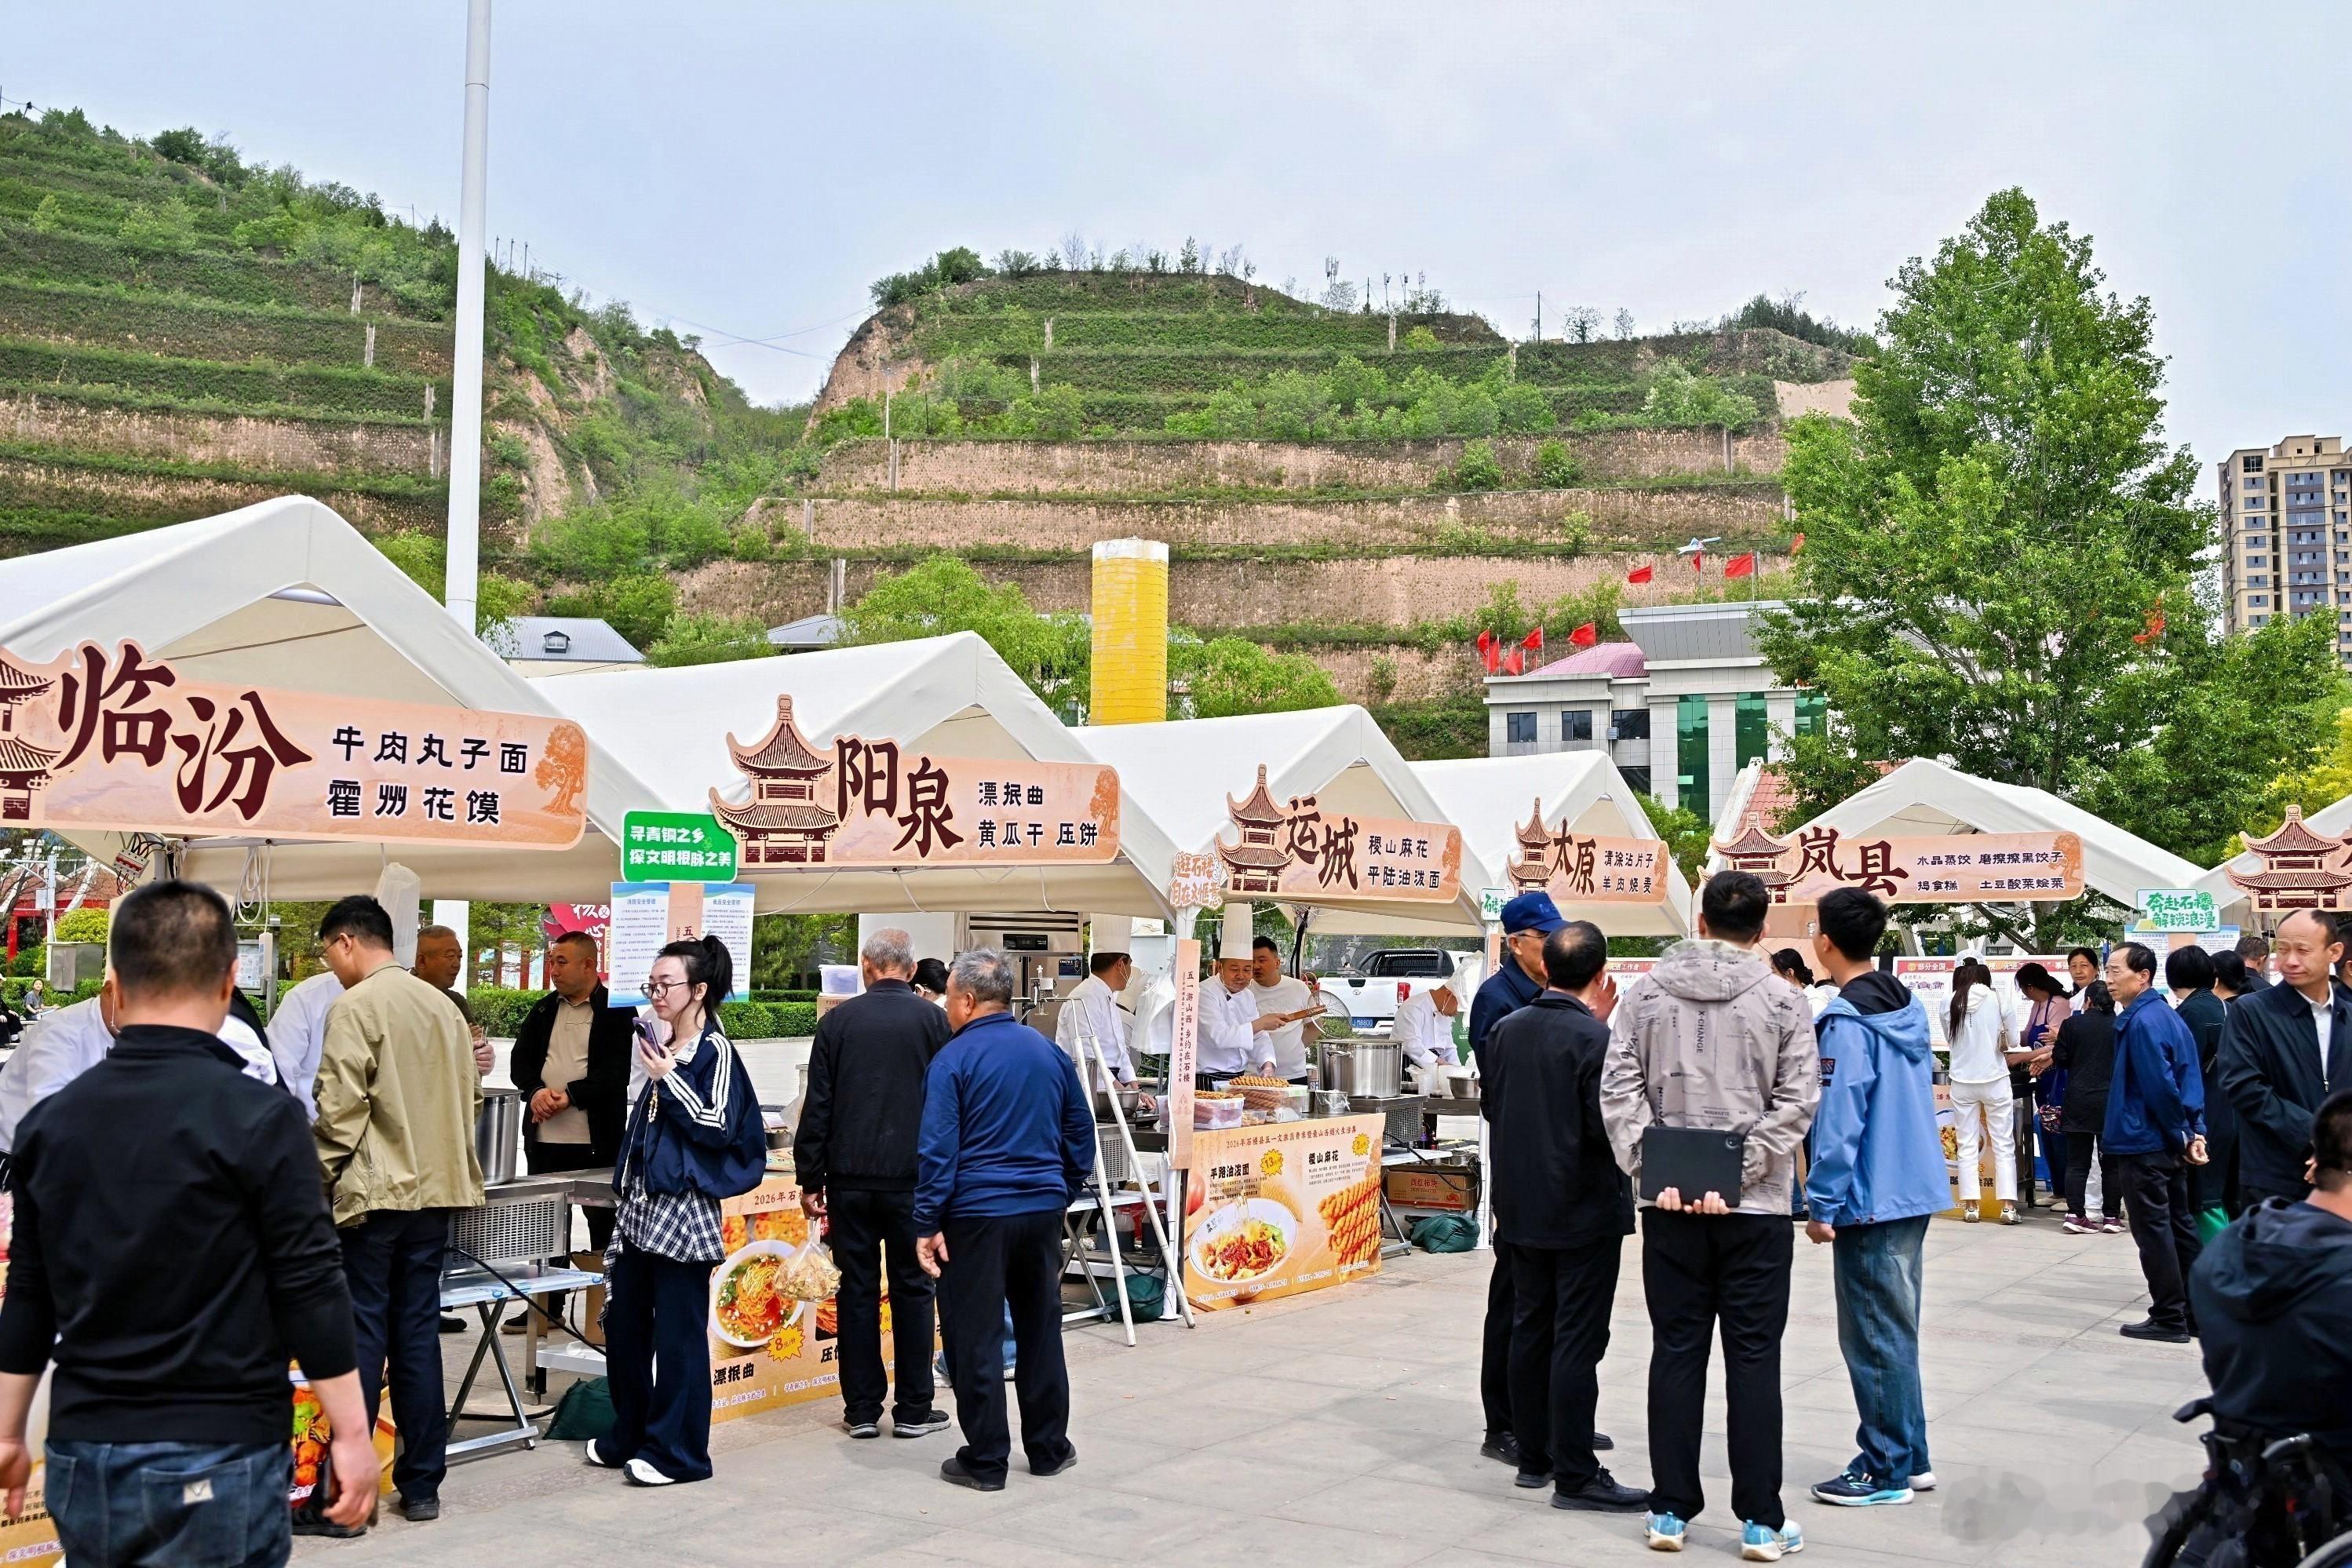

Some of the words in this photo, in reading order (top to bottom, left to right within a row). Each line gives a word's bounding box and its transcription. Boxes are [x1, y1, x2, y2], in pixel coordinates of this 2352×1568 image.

[53, 644, 313, 820] 临汾
[333, 726, 527, 773] 牛肉丸子面
[326, 779, 500, 824] 霍州花馍
[835, 738, 965, 857] 阳泉
[630, 826, 705, 843] 寻青铜之乡
[979, 819, 1043, 848] 黄瓜干
[1056, 822, 1097, 846] 压饼
[1285, 797, 1358, 890] 运城
[1368, 836, 1428, 858] 稷山麻花
[629, 848, 731, 866] 探文明根脉之美
[1549, 819, 1596, 895] 太原
[1790, 826, 1909, 896] 岚县
[1917, 855, 1971, 866] 水晶蒸饺
[1368, 866, 1440, 888] 平陆油泼面
[1603, 875, 1651, 893] 羊肉烧麦
[1980, 878, 2064, 889] 土豆酸菜烩菜
[1172, 880, 1222, 908] 自在又惬意
[2153, 911, 2215, 929] 解锁浪漫
[1186, 971, 1194, 1023] 五一游山西
[1309, 1150, 1339, 1165] 稷山麻花
